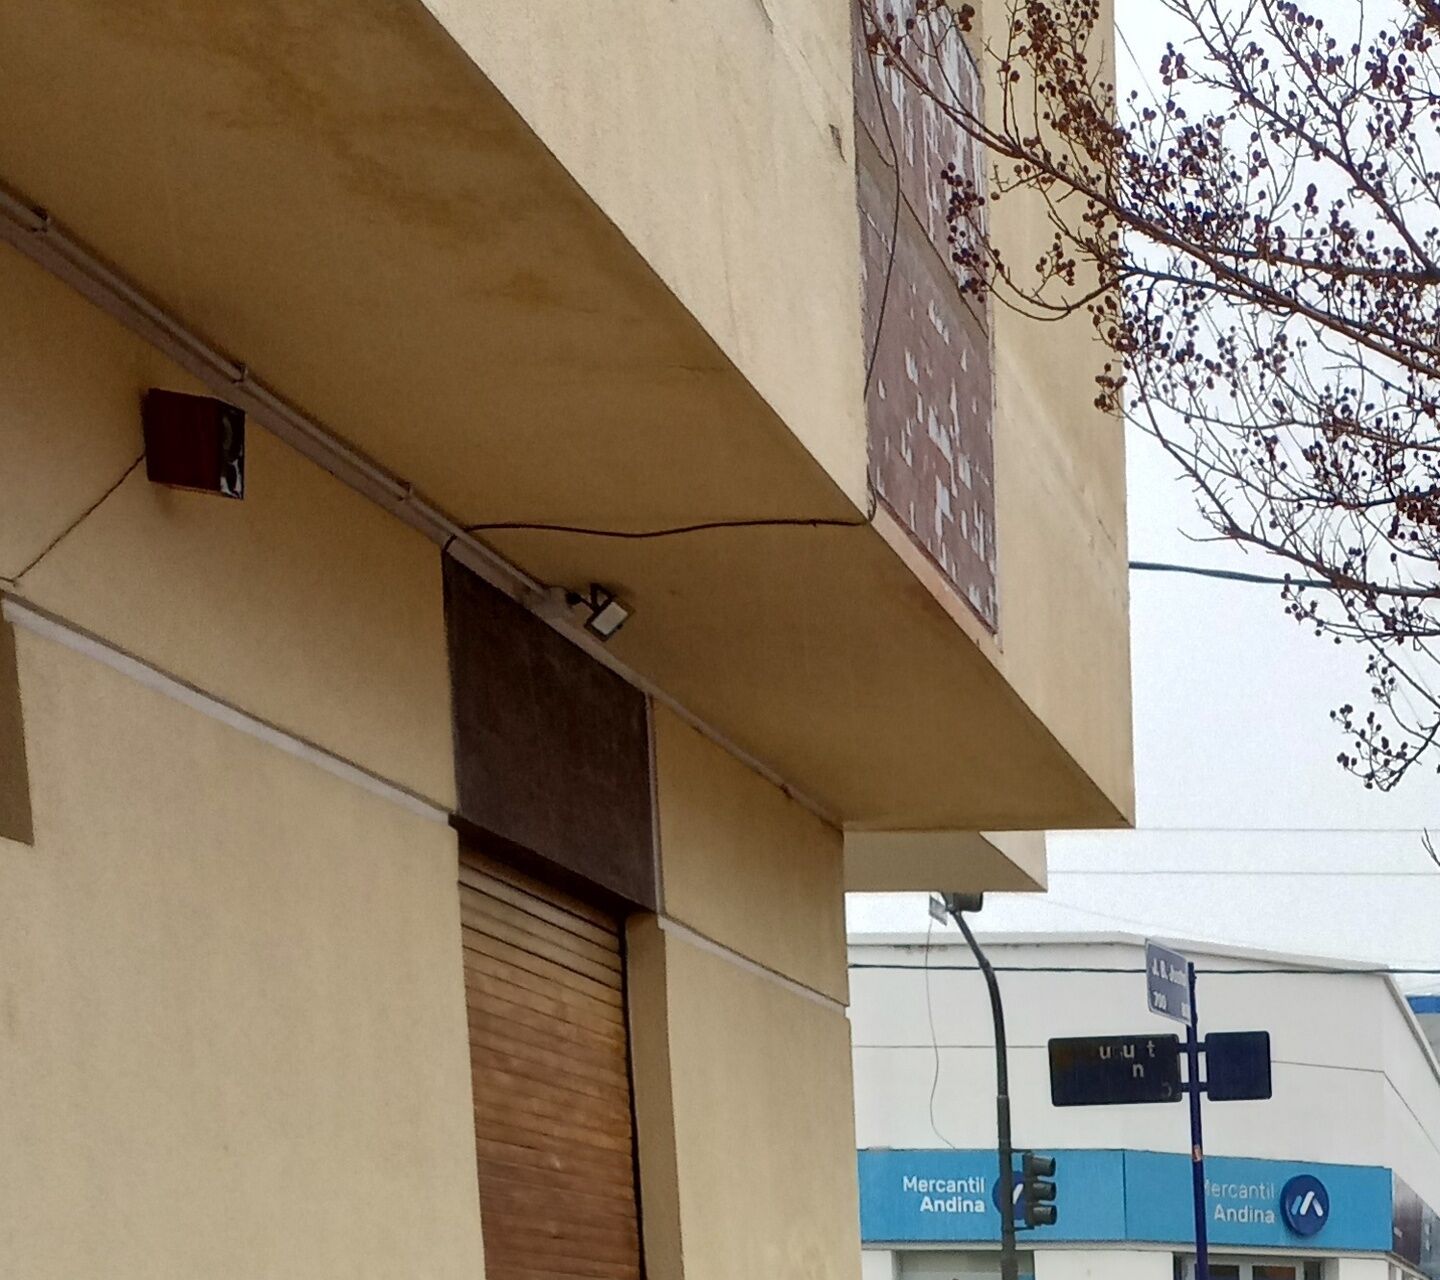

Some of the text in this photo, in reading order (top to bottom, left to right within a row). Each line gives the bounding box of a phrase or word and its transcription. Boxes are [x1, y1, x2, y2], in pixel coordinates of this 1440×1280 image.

[903, 1176, 984, 1193] Mercantil
[920, 1196, 985, 1213] Andina
[1214, 1204, 1275, 1224] Andina
